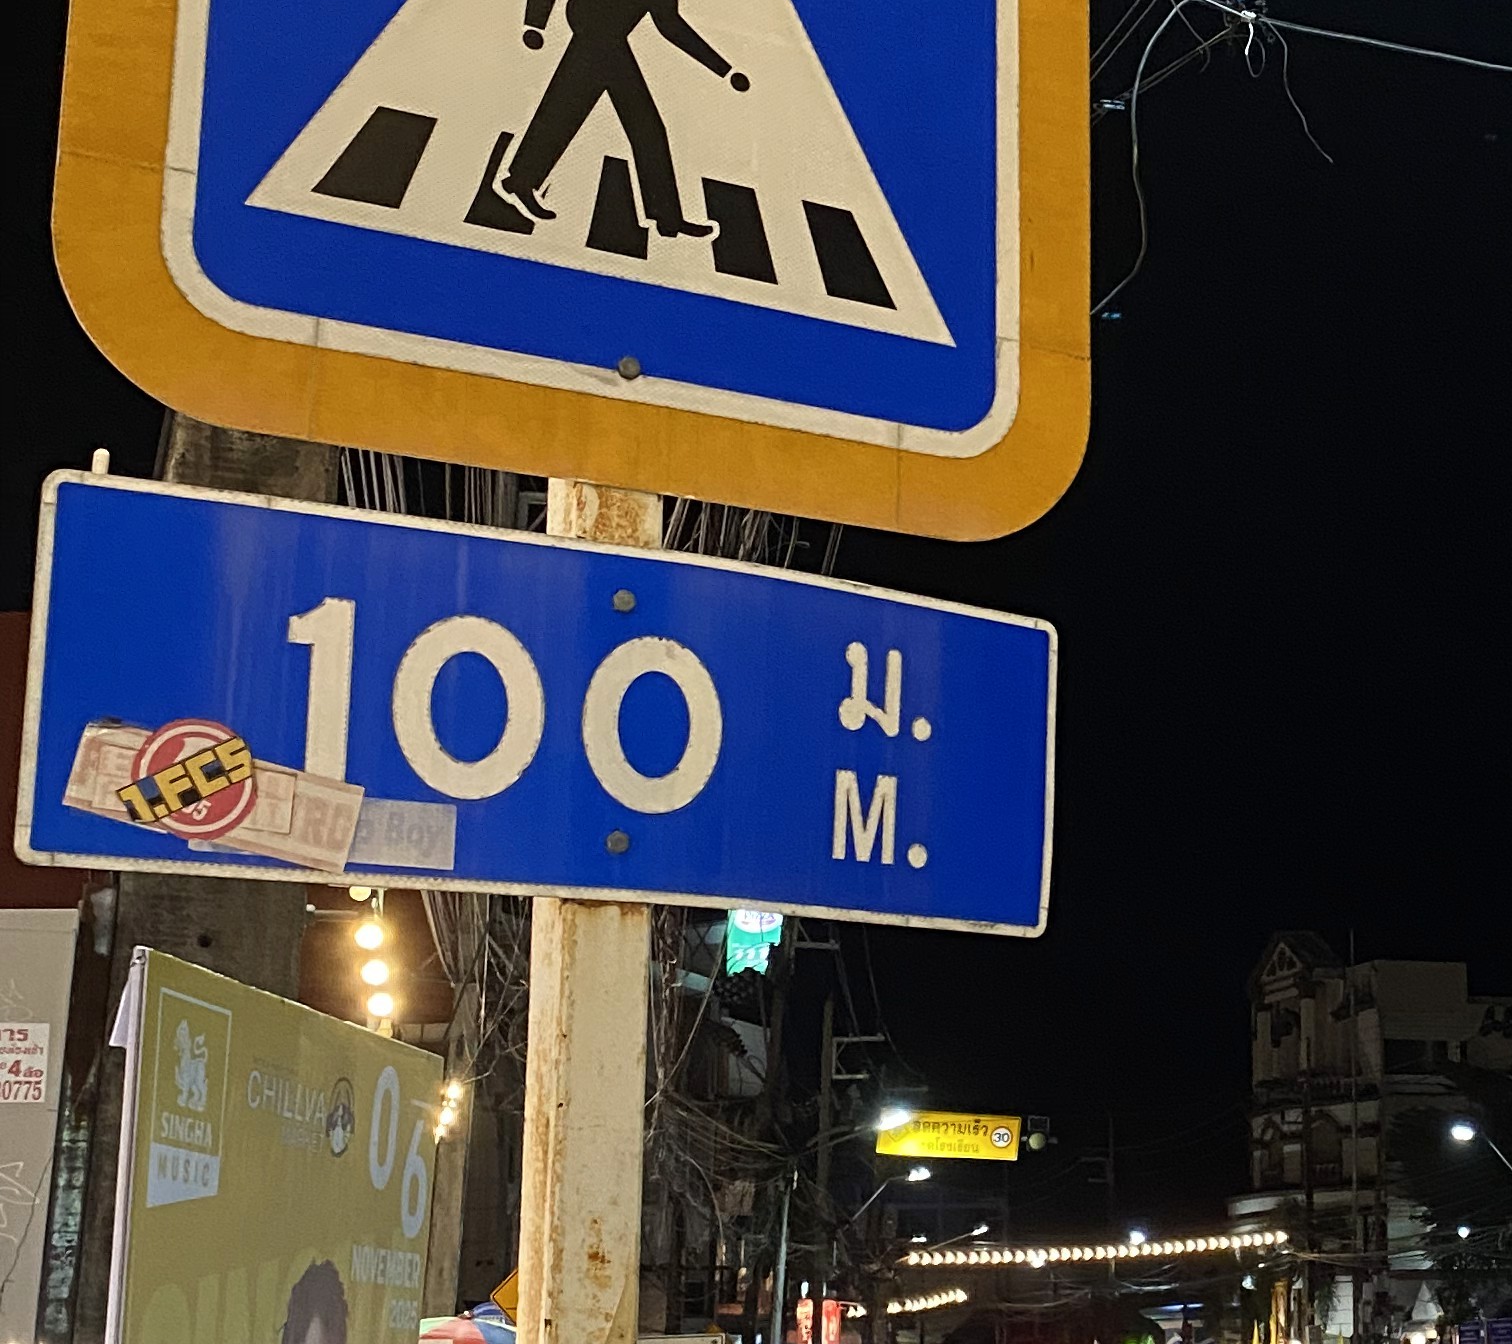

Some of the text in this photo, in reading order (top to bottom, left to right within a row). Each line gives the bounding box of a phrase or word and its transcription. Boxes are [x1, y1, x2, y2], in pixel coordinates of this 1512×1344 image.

[286, 596, 724, 814] 100
[838, 642, 931, 741] ม.
[832, 770, 928, 868] M.
[246, 1070, 327, 1126] CHILLVA
[161, 1112, 212, 1148] SINGHA
[368, 1065, 428, 1239] 06
[913, 1119, 1010, 1143] ลดความเร็ว 30
[157, 1153, 210, 1188] MUSIC
[352, 1245, 420, 1289] NOVEMBER
